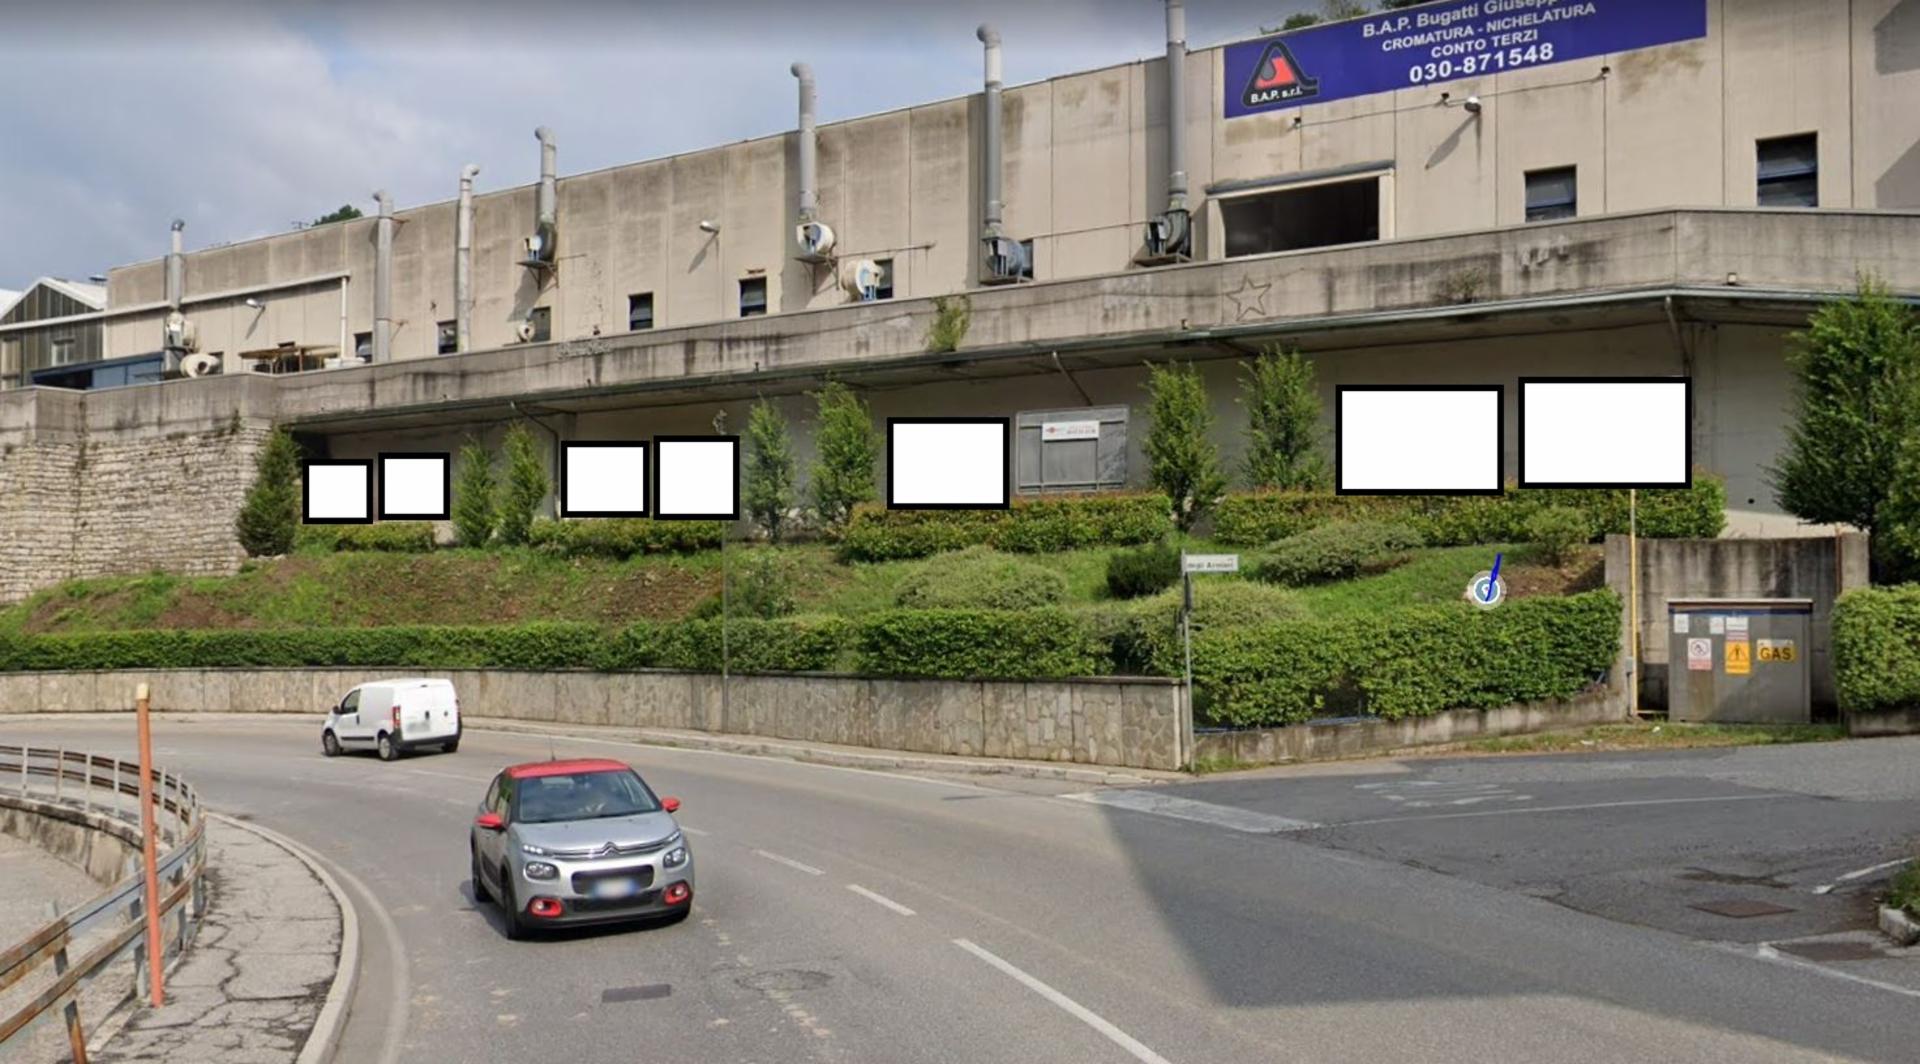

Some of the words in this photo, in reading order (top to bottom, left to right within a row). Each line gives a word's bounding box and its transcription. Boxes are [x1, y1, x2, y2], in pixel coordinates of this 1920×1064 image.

[1363, 16, 1412, 38] B.A.P.
[1417, 3, 1479, 28] Bugatti
[1382, 25, 1475, 52] CROMATURA
[1486, 2, 1596, 33] NICHELATURA
[1431, 38, 1487, 58] CONTO
[1491, 29, 1538, 48] TERZI
[1409, 42, 1554, 83] 030-871548
[1250, 89, 1280, 103] B.A.P.
[1760, 647, 1792, 661] GAS
